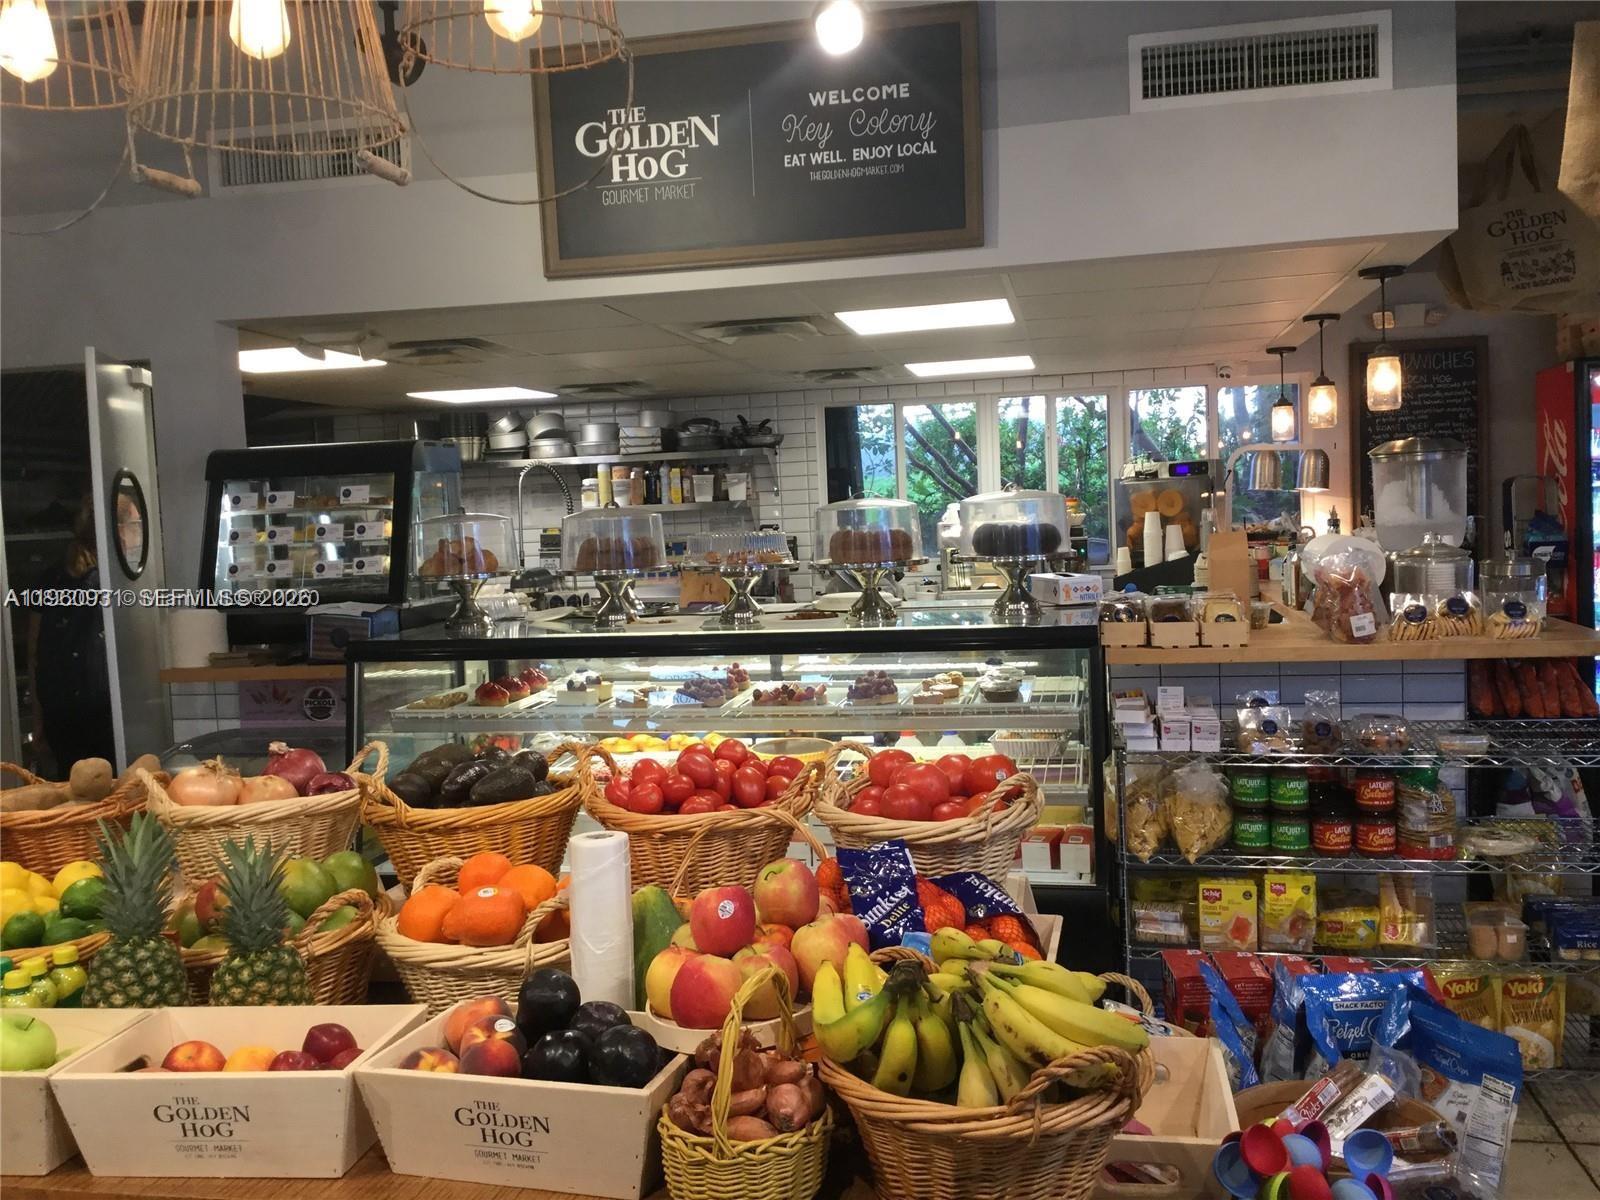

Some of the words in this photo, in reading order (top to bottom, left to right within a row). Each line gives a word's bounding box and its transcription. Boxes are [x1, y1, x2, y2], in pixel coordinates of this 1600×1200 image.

[809, 83, 910, 107] WELCOME
[608, 106, 646, 124] THE
[575, 114, 721, 158] GOLDEN
[781, 113, 832, 148] Key
[849, 107, 937, 140] Colony
[784, 153, 808, 168] EAT
[809, 150, 847, 167] WELL.
[852, 145, 894, 162] ENJOY
[897, 141, 937, 157] LOCAL
[809, 163, 905, 181] THEGOLDENHOGMARKET.COM
[602, 187, 650, 206] GOURMET
[654, 183, 696, 202] MARKET
[1487, 210, 1567, 237] GOLDEN
[965, 873, 1024, 914] Sunkist
[857, 884, 915, 931] Sunkist
[880, 902, 911, 928] Delite
[1577, 940, 1598, 948] Rice
[172, 1096, 200, 1105] THE
[473, 1099, 501, 1112] THE
[153, 1104, 251, 1123] GOLDEN
[454, 1107, 551, 1134] GOLDEN
[213, 1144, 242, 1153] MARKET
[512, 1153, 541, 1163] MARKET
